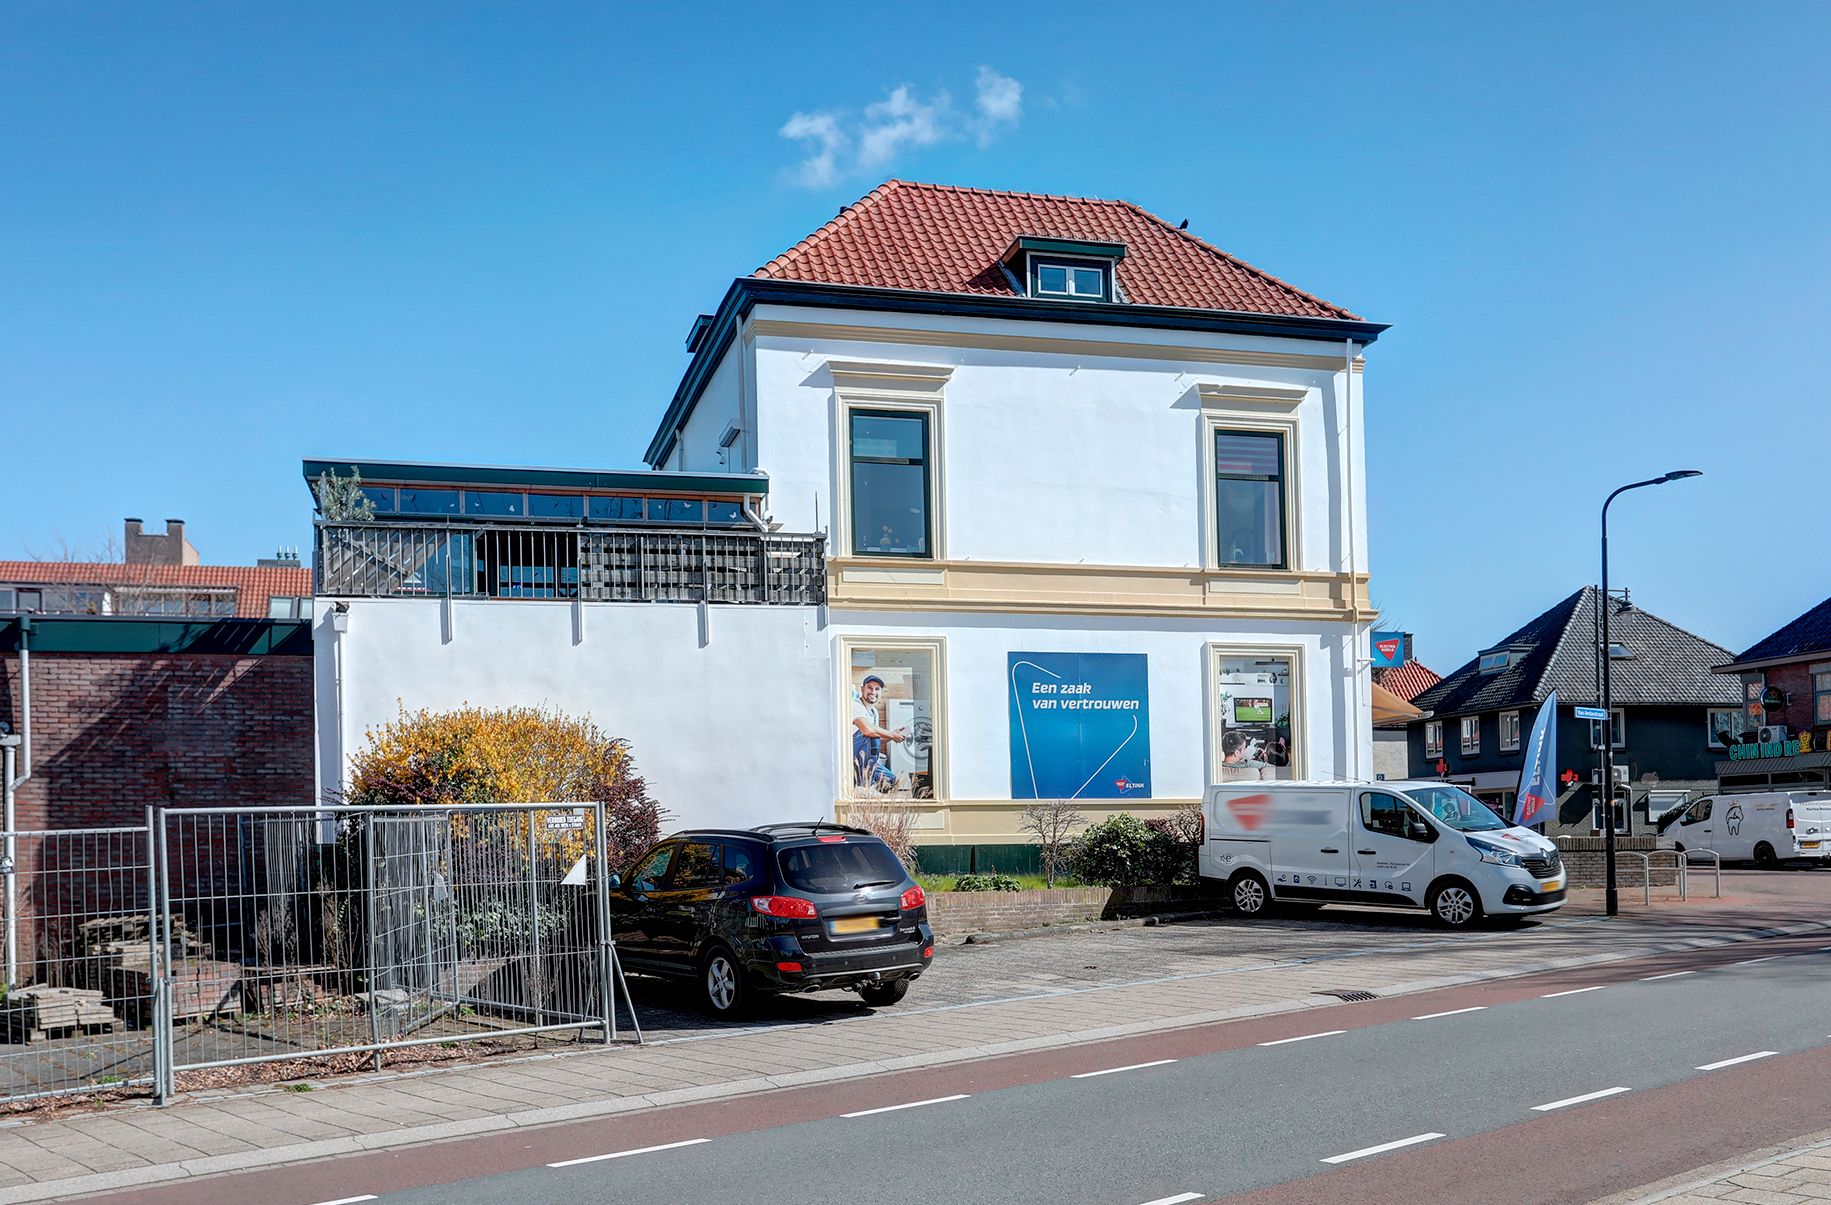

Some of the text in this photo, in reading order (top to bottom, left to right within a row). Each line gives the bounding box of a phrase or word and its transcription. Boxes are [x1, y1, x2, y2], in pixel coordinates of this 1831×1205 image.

[1032, 682, 1092, 694] Een zaak
[1032, 699, 1140, 710] van vertrouwen
[1531, 727, 1546, 786] ELTINK
[1729, 743, 1759, 760] CHIN
[1760, 742, 1783, 758] IND
